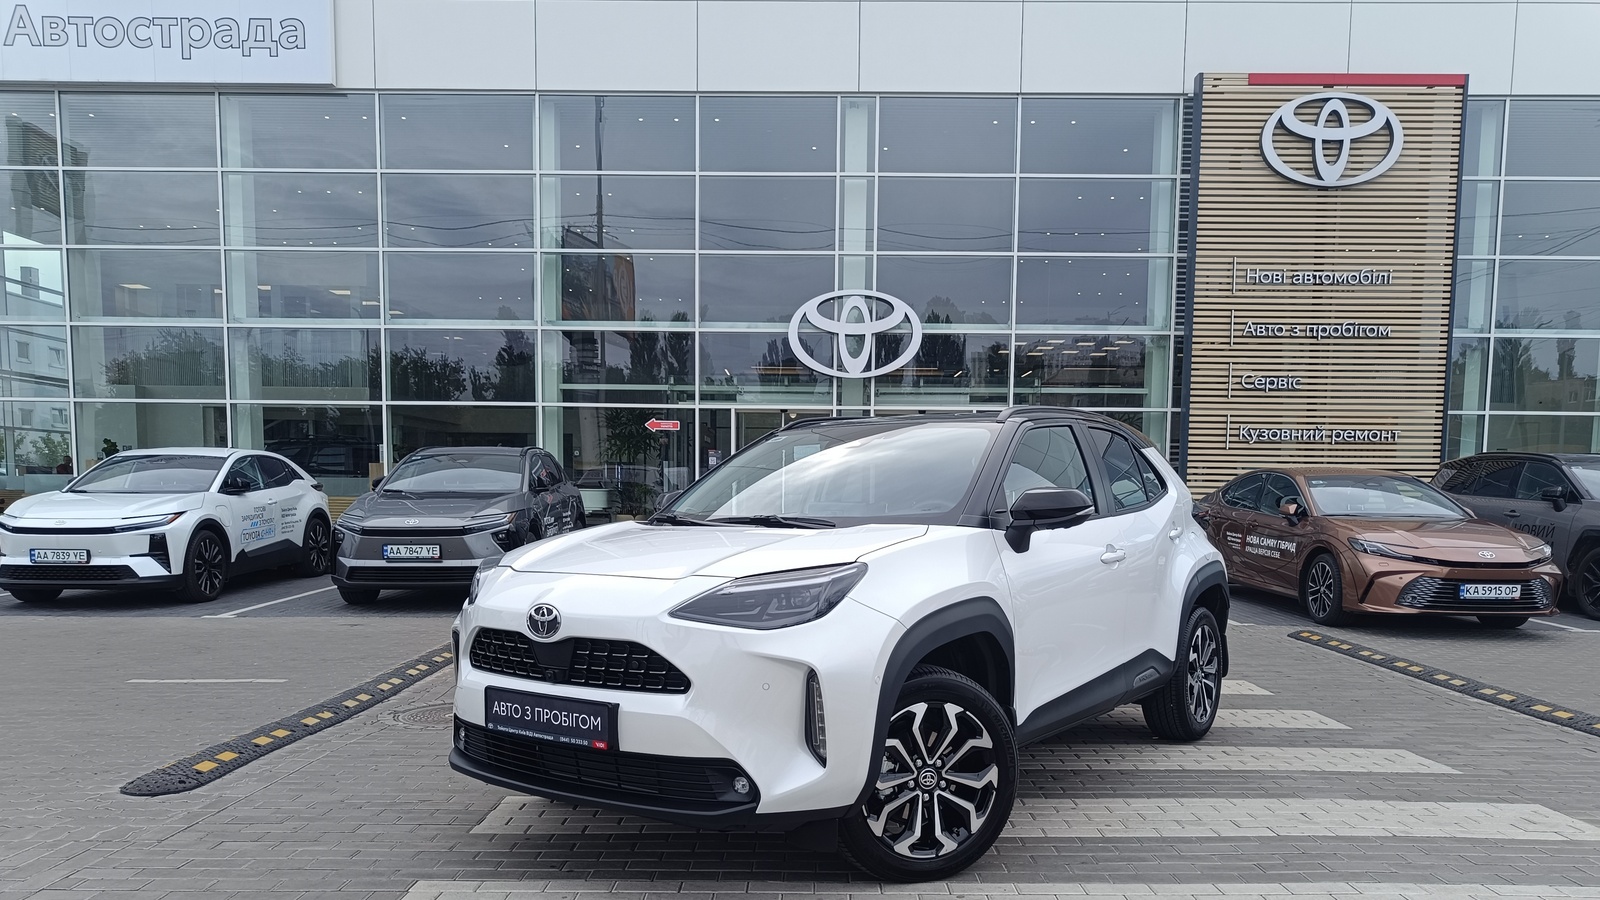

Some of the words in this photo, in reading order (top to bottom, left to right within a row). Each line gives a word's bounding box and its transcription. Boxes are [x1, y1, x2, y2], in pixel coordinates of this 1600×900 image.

[3, 3, 306, 60] Автострада
[1245, 267, 1287, 284] Нові
[1291, 268, 1393, 285] автомобілі
[1242, 321, 1286, 337] Авто
[1290, 324, 1300, 337] з
[1305, 321, 1392, 341] пробігом
[1240, 374, 1303, 392] Сервіс
[1238, 425, 1326, 444] Кузовний
[1331, 428, 1401, 445] ремонт
[243, 531, 260, 541] TOYOTA
[1246, 535, 1260, 544] НОВА
[1260, 537, 1278, 548] CAMRY
[36, 551, 49, 560] AA
[50, 551, 71, 560] 7839
[73, 551, 86, 560] YE
[389, 547, 402, 555] AA
[403, 547, 424, 555] 7847
[426, 547, 438, 555] YE
[1465, 585, 1480, 596] KA
[1481, 586, 1503, 596] 5915
[1504, 586, 1519, 596] OP
[492, 700, 522, 719] АВТО
[524, 706, 532, 720] З
[534, 707, 602, 732] ПРОБІГОМ
